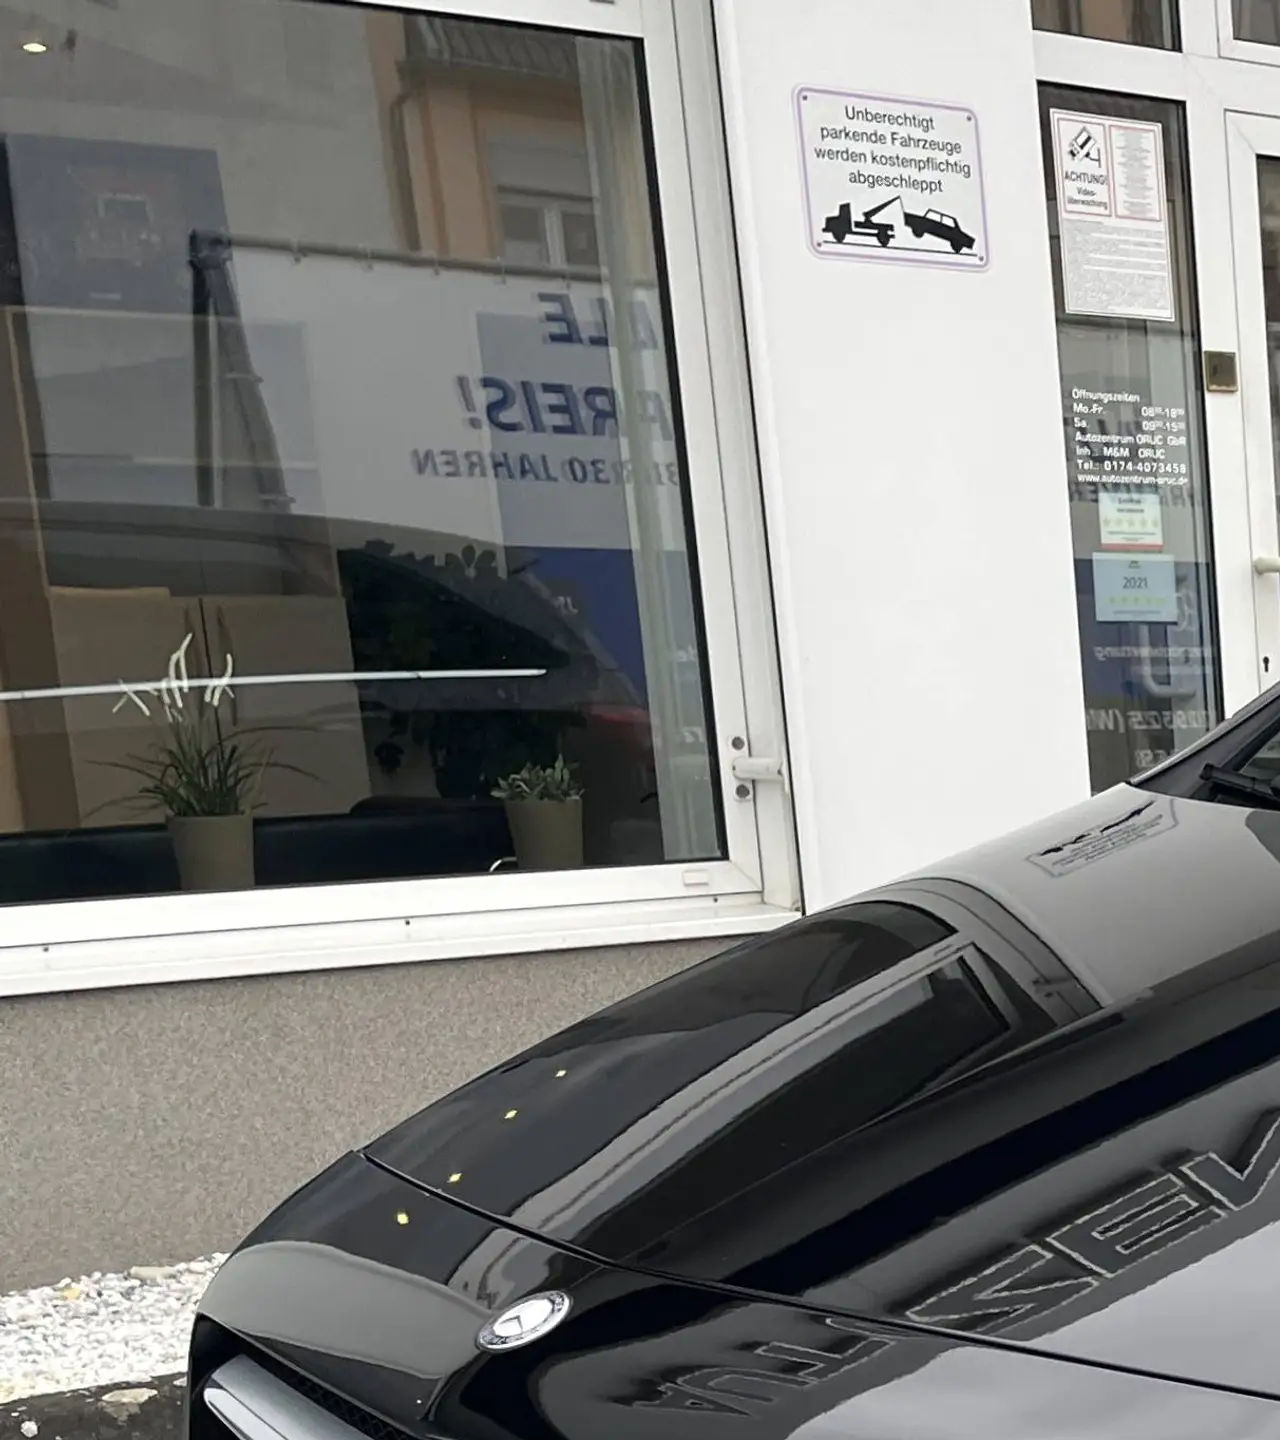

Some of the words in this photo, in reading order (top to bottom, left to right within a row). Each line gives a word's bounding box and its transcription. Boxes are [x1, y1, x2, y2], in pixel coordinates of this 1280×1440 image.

[845, 105, 936, 132] Unberechtigt
[820, 125, 887, 146] parkende
[890, 131, 962, 155] Fahrzeuge
[814, 146, 867, 164] werden
[870, 151, 971, 178] kostenpflichtig
[849, 169, 943, 194] abgeschleppt
[1075, 431, 1135, 444] Autozentrum
[1136, 434, 1164, 446] ORUC
[1138, 448, 1166, 459] ORUC
[1122, 576, 1149, 589] 2021
